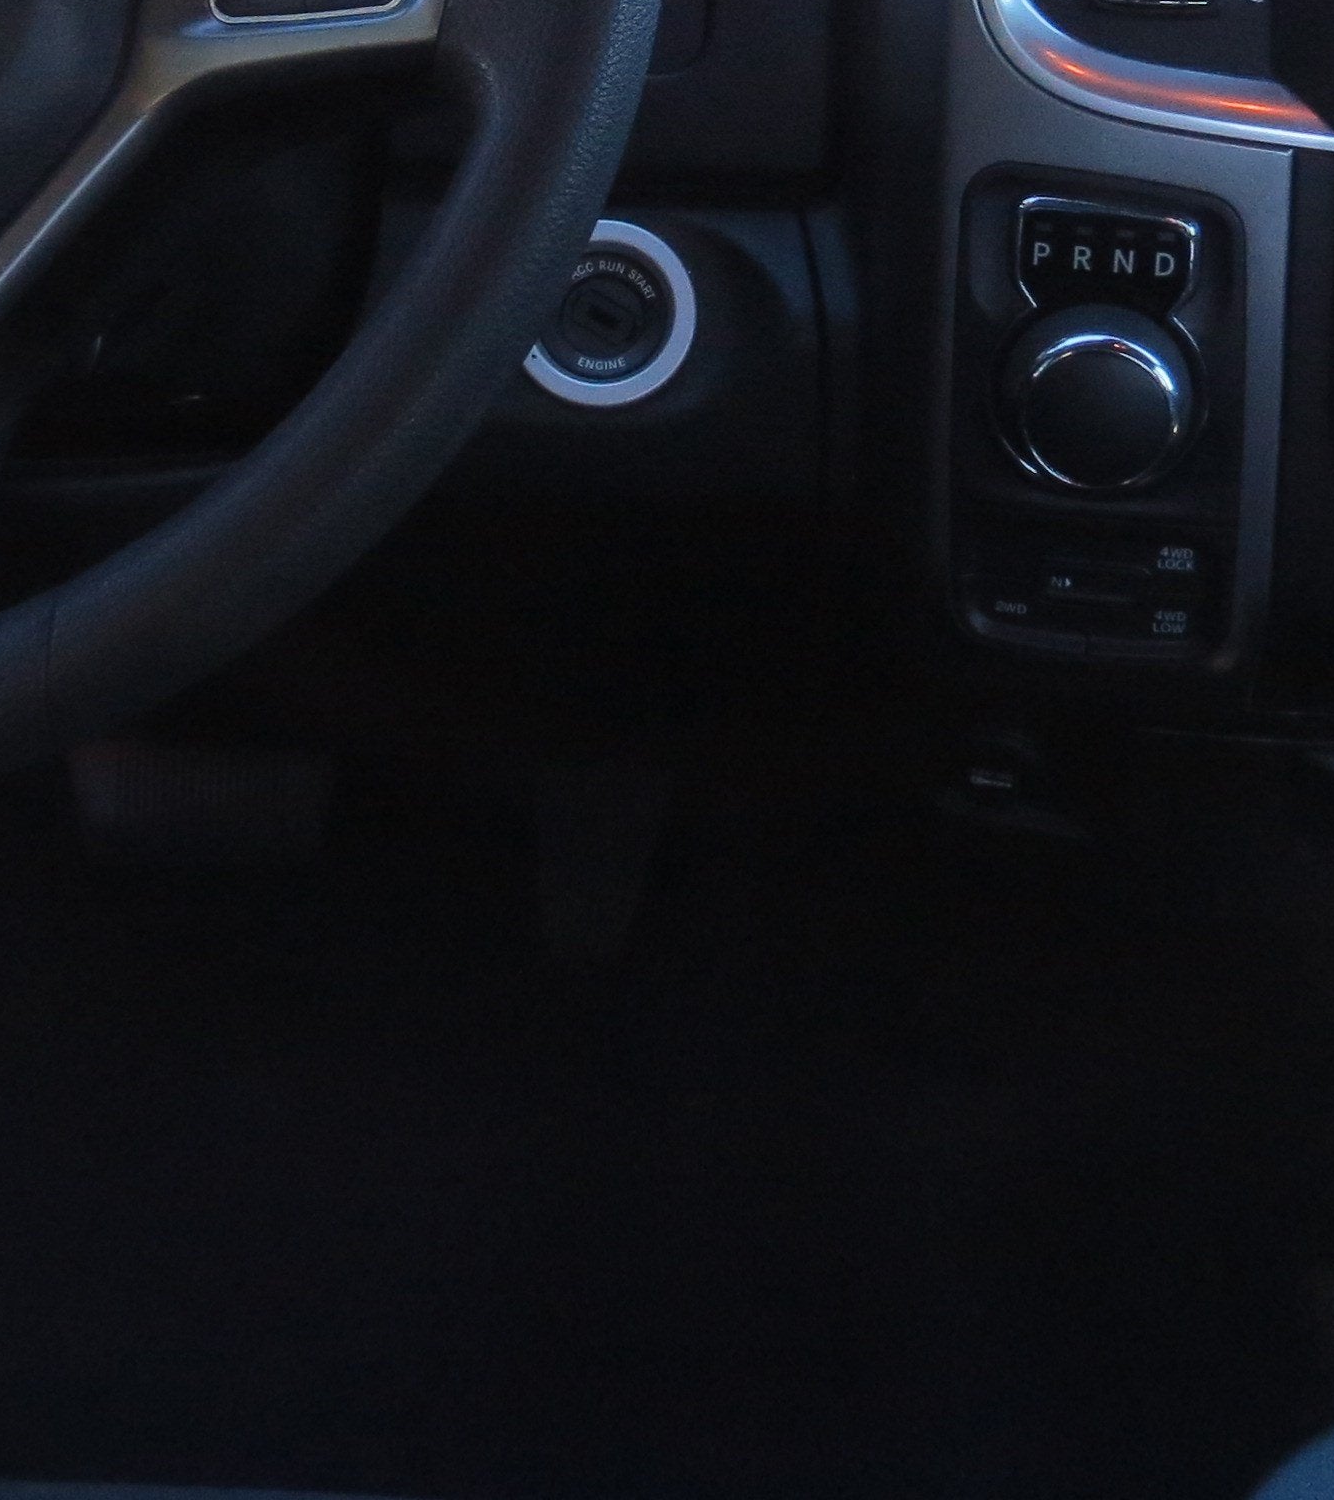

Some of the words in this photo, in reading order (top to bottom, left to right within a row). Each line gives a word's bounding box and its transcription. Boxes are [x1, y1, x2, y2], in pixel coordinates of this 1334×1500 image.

[1031, 241, 1052, 268] P
[1073, 245, 1094, 272] R
[1113, 248, 1135, 275] N
[1154, 252, 1176, 278] D
[598, 259, 626, 275] RUN
[627, 268, 657, 301] START
[576, 355, 627, 372] ENGINE
[1156, 557, 1195, 571] LOCK
[1152, 621, 1187, 634] LOW
